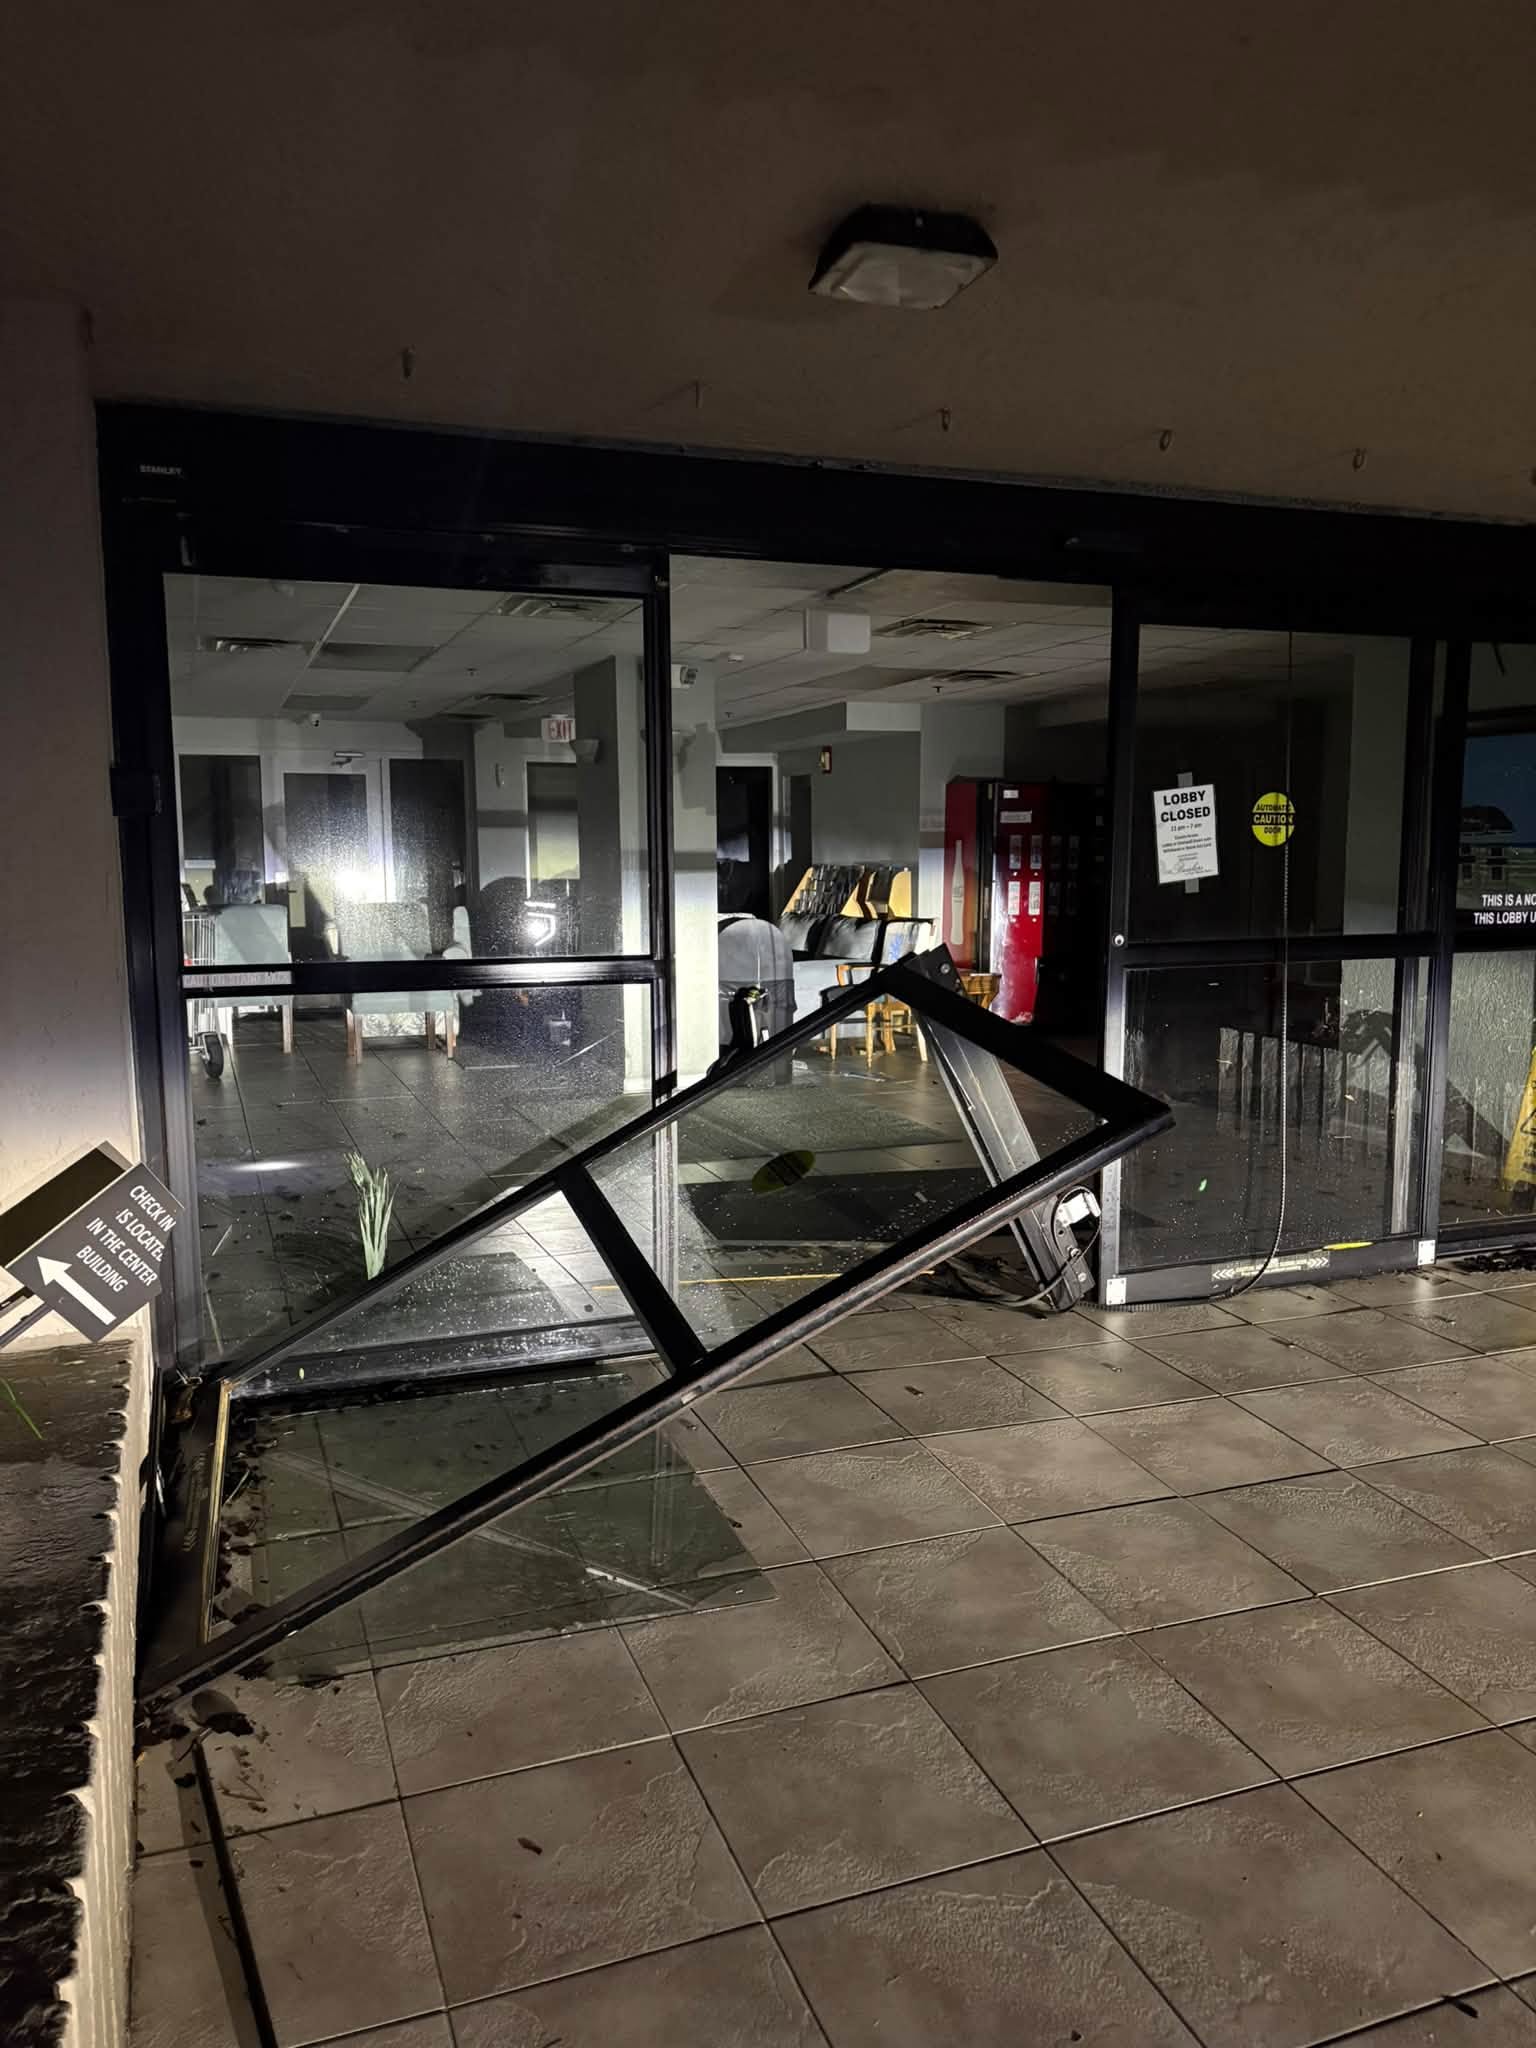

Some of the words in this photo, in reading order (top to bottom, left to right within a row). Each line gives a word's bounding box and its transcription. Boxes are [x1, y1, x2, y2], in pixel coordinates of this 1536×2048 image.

[1163, 790, 1206, 806] LOBBY
[1160, 806, 1210, 822] CLOSED
[1253, 814, 1294, 824] CAUTION
[1482, 894, 1503, 907] THIS
[1504, 894, 1514, 906] IS
[1515, 894, 1523, 906] A
[1473, 912, 1495, 925] THIS
[1497, 911, 1529, 924] LOBBY
[115, 1208, 131, 1224] IS
[130, 1185, 161, 1221] CHECK
[157, 1214, 177, 1232] IN
[86, 1217, 102, 1235] IN
[99, 1226, 126, 1253] THE
[118, 1247, 158, 1287] CENTER
[76, 1245, 128, 1292] BUILDING
